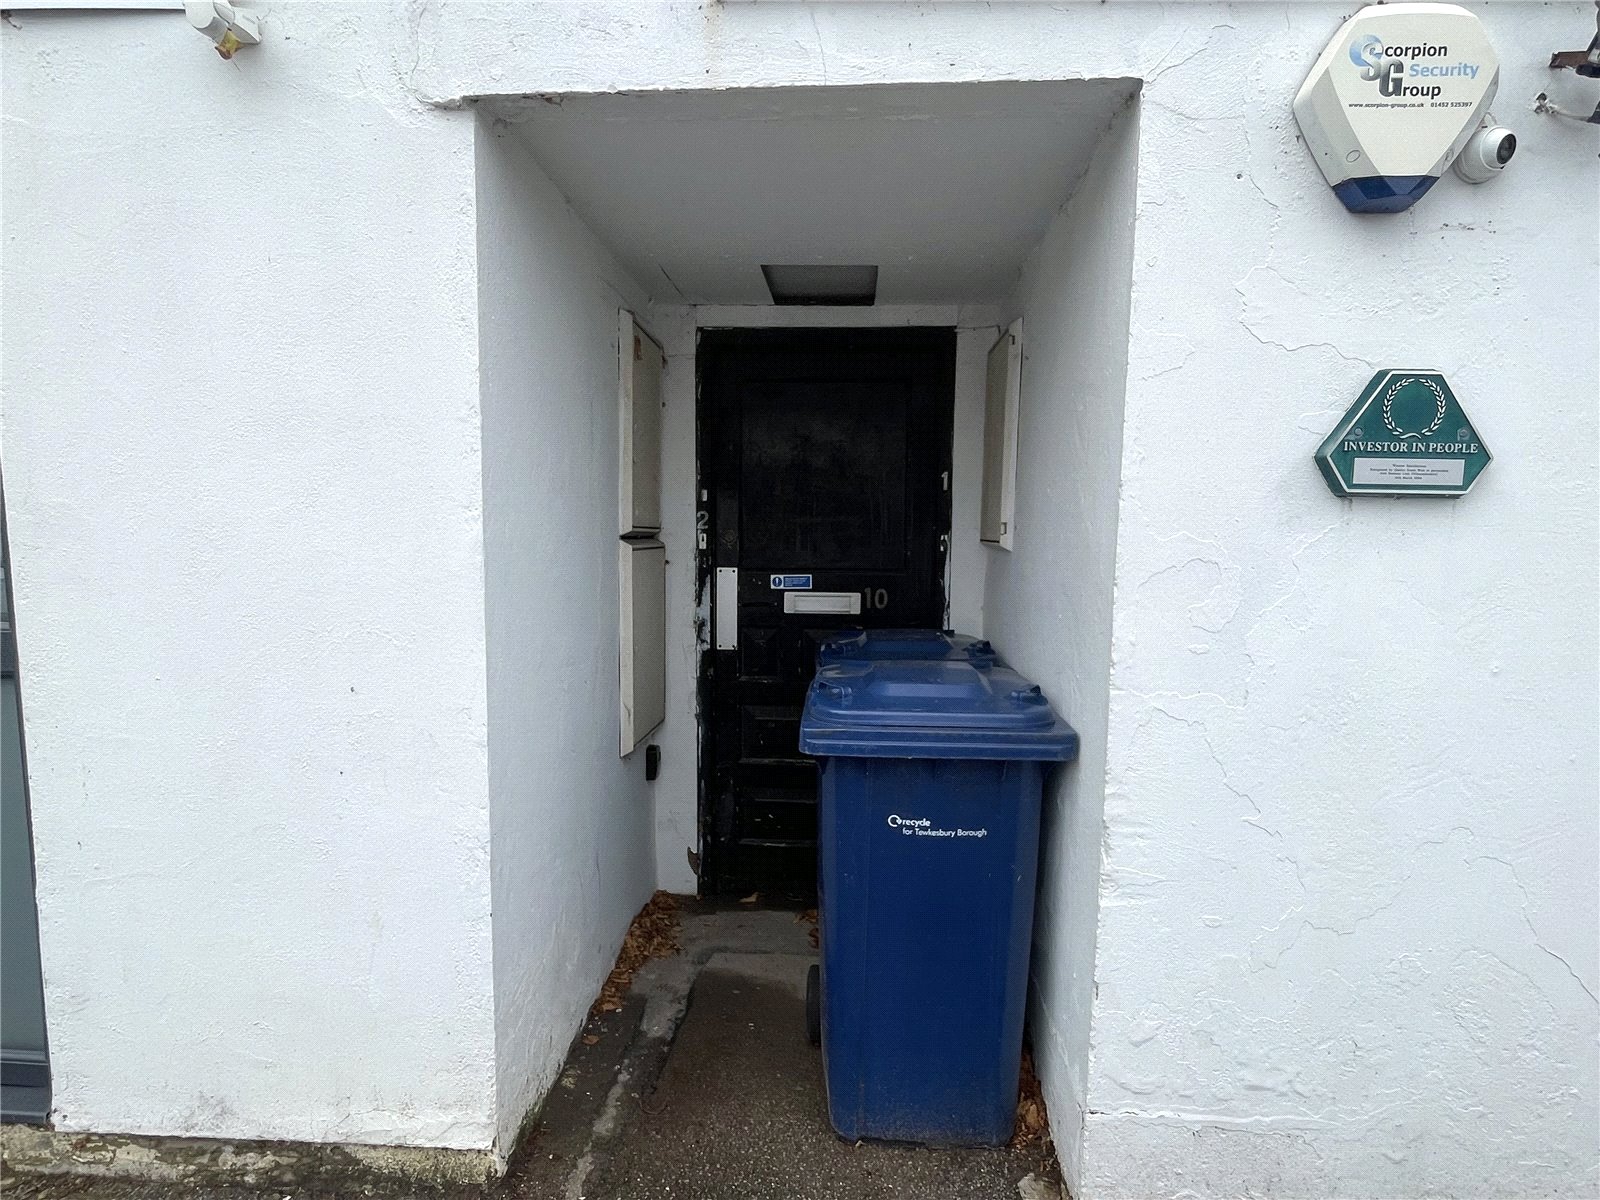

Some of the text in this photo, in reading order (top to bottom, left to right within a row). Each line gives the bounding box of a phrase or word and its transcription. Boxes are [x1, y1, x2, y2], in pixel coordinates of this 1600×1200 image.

[1360, 42, 1448, 81] Scorpion
[1409, 62, 1480, 79] Security
[1379, 59, 1442, 99] Group
[1343, 441, 1479, 454] INVESTOR IN PEOPLE
[941, 471, 949, 491] 1
[696, 510, 709, 530] 2
[864, 587, 888, 609] 10
[902, 817, 931, 828] recycle
[902, 827, 988, 838] for Tewkesbury Borough
